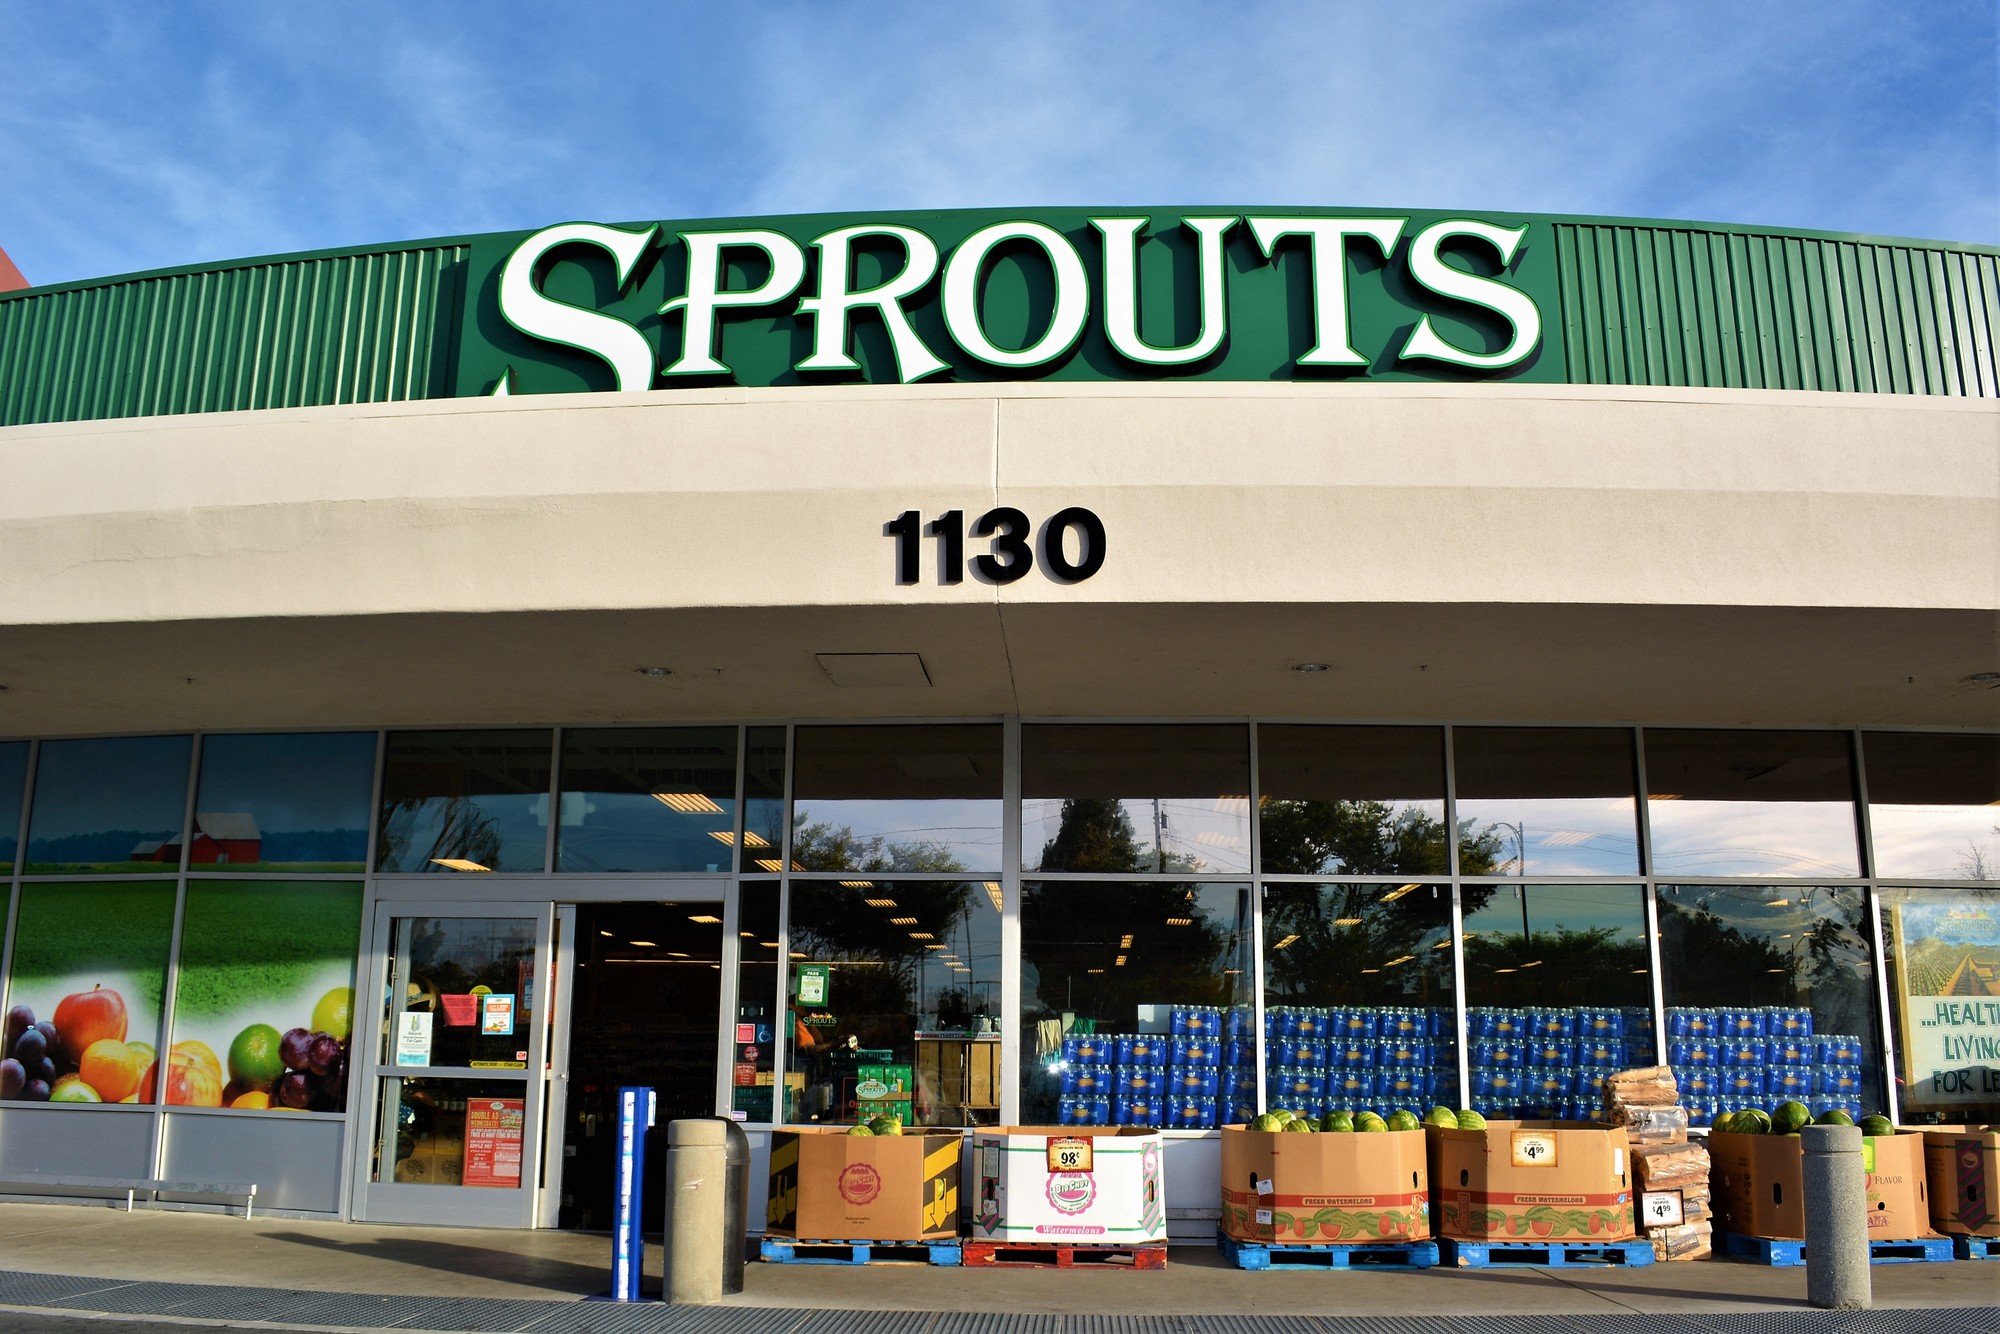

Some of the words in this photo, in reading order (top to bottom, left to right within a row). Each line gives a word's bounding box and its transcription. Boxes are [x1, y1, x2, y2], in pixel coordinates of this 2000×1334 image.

[488, 214, 1543, 396] SPROUTS
[888, 507, 1107, 586] 1130
[1935, 917, 1999, 935] SPROUTS
[803, 1016, 837, 1027] SPROUTS
[1933, 1070, 1974, 1094] FOR
[471, 1111, 490, 1120] DOUBLE
[491, 1112, 499, 1120] AD
[1042, 1225, 1101, 1235] Watermelons
